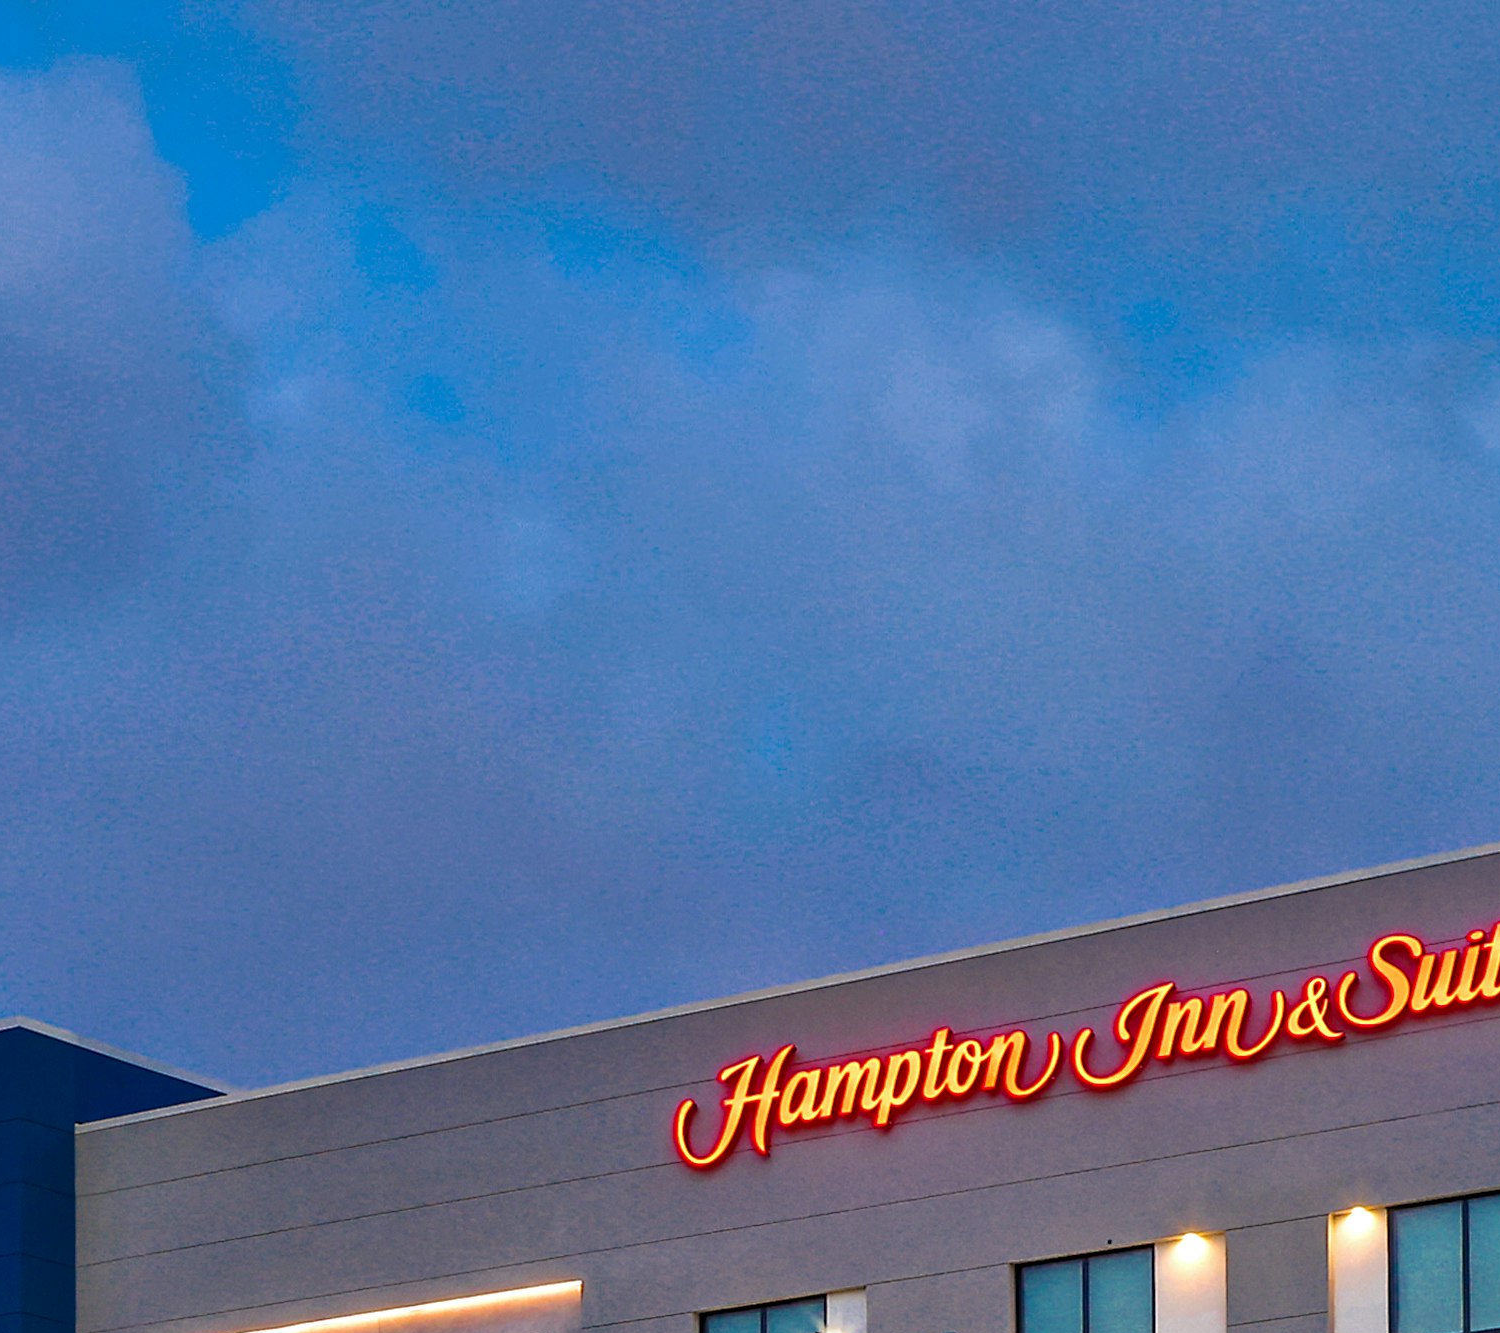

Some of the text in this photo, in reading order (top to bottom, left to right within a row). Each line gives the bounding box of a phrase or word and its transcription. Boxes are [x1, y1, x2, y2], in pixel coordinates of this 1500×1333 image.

[674, 1028, 1059, 1167] Hampton
[1071, 983, 1283, 1088] Inn
[1285, 976, 1343, 1040] &
